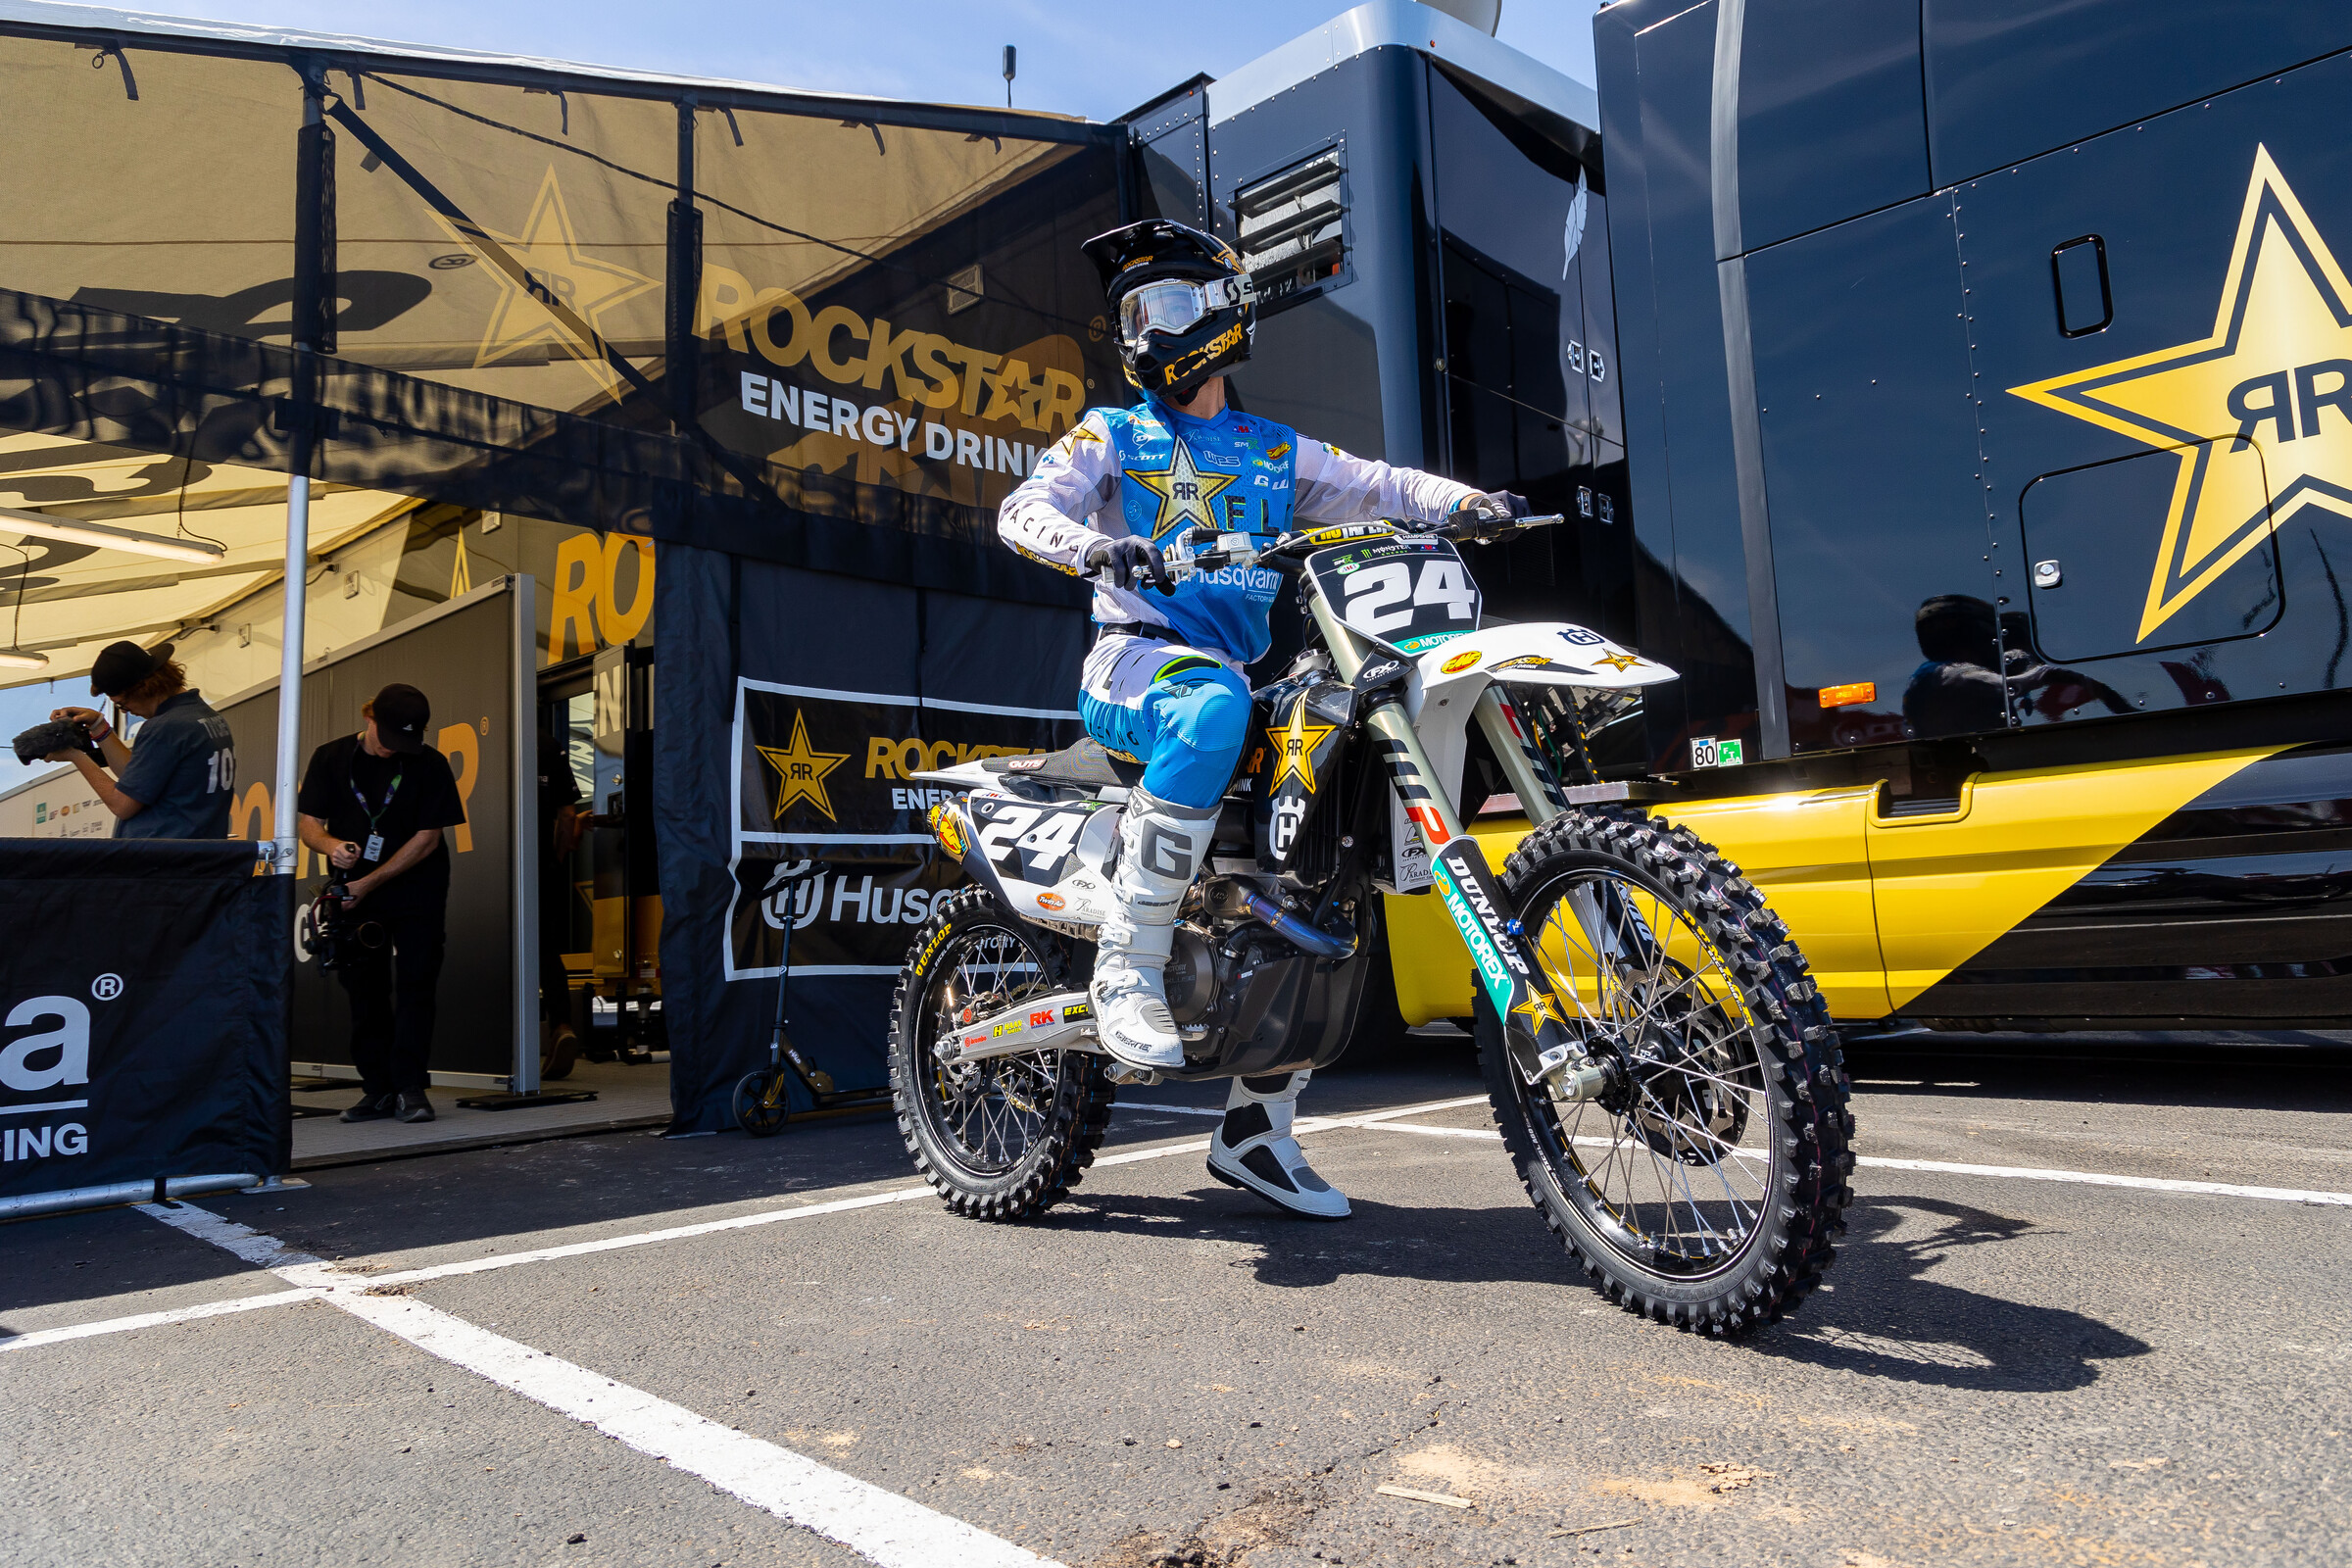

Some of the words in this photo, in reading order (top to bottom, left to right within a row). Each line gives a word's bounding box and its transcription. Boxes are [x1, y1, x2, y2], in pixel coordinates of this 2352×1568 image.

[741, 370, 917, 453] ENERGY
[1127, 453, 1167, 463] SCOTT
[1203, 451, 1242, 466] WPS
[1373, 544, 1411, 555] MONSTER
[1344, 561, 1476, 637] 24
[865, 737, 1066, 780] ROCK
[1695, 746, 1715, 765] 80
[979, 806, 1087, 871] 24
[1039, 895, 1054, 906] Twin
[1054, 900, 1065, 908] Air
[1446, 856, 1531, 975] DUNLOP
[915, 923, 953, 977] DUNLOP
[1447, 894, 1509, 990] MOTOREX
[1030, 1009, 1054, 1027] RK
[1064, 1005, 1088, 1015] EXC
[1004, 1019, 1023, 1030] HAAN
[1115, 1030, 1152, 1053] GAERNE
[0, 1122, 88, 1162] ING
